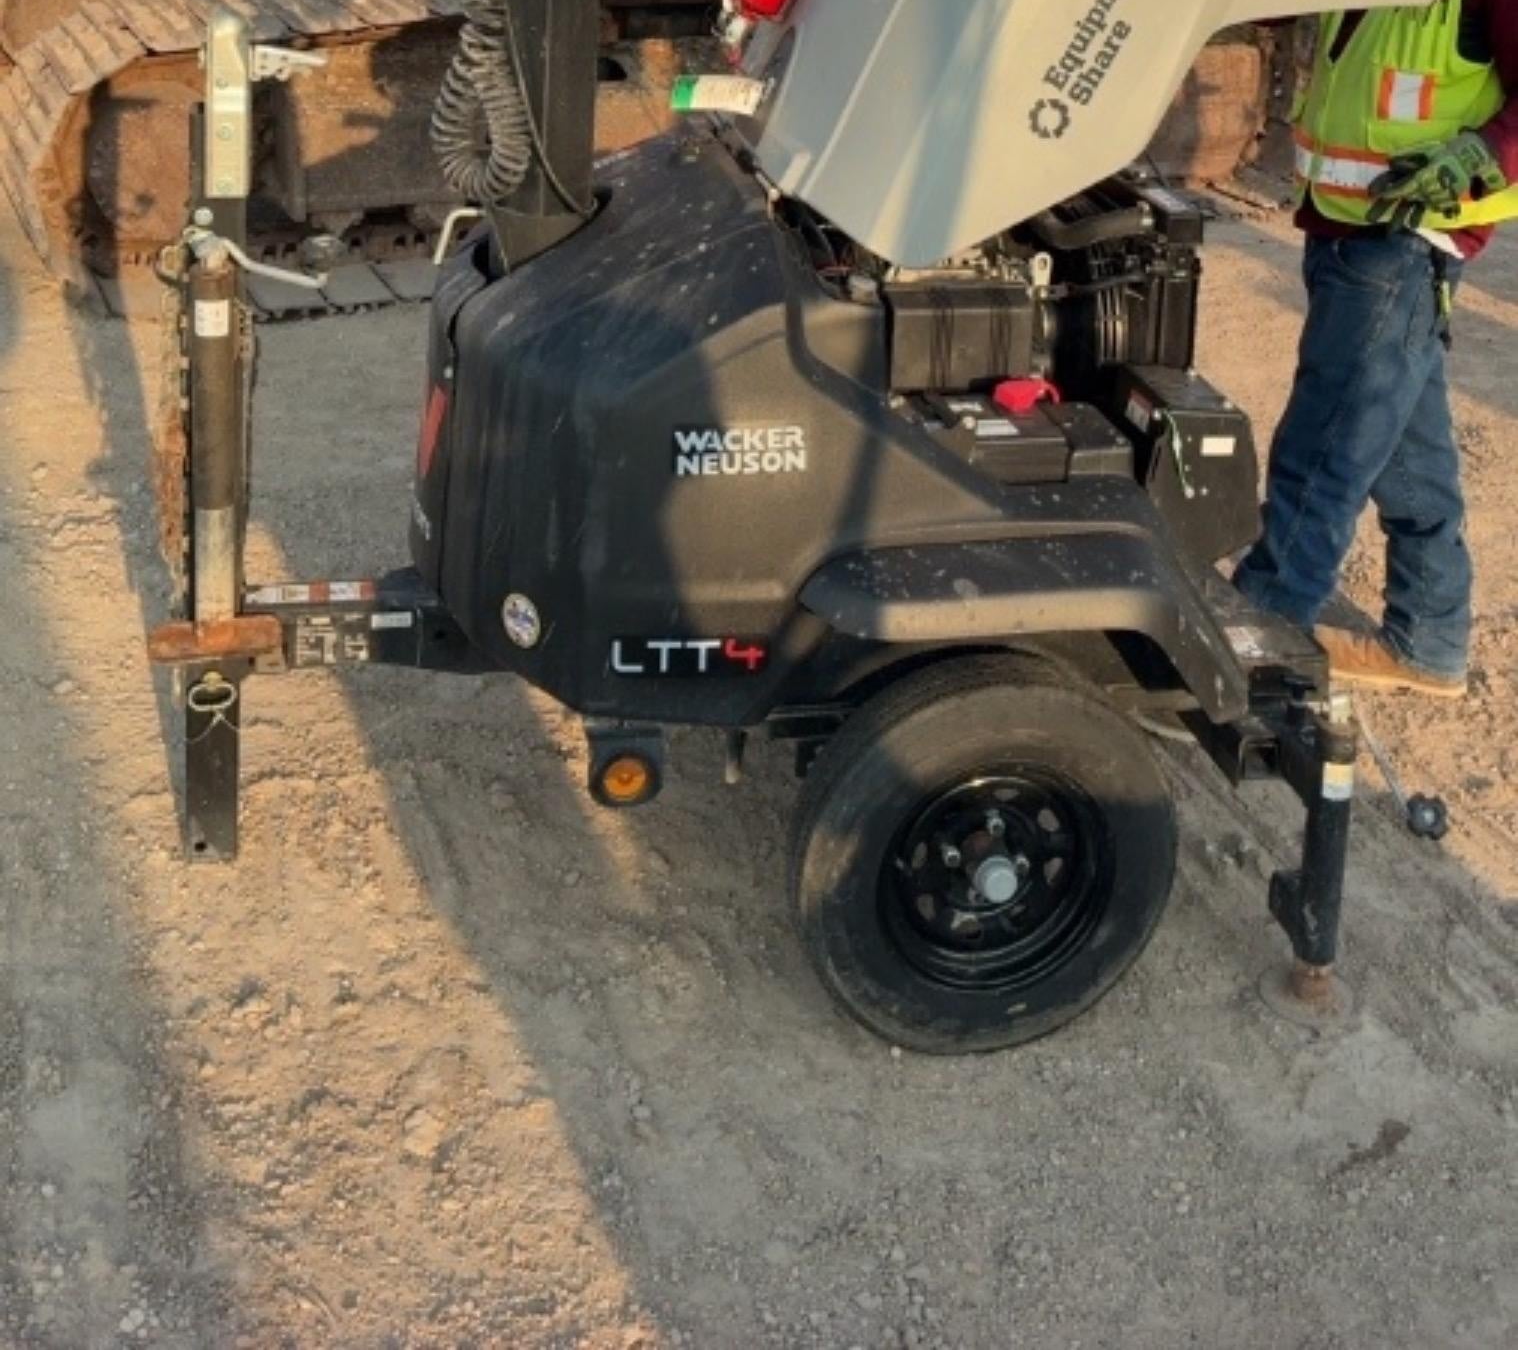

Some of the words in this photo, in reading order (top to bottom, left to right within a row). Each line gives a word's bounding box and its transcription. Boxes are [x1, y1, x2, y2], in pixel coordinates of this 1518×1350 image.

[1067, 19, 1132, 106] Share
[673, 425, 807, 452] WACKER
[676, 449, 807, 477] NEUSON
[612, 637, 765, 674] LTT4
